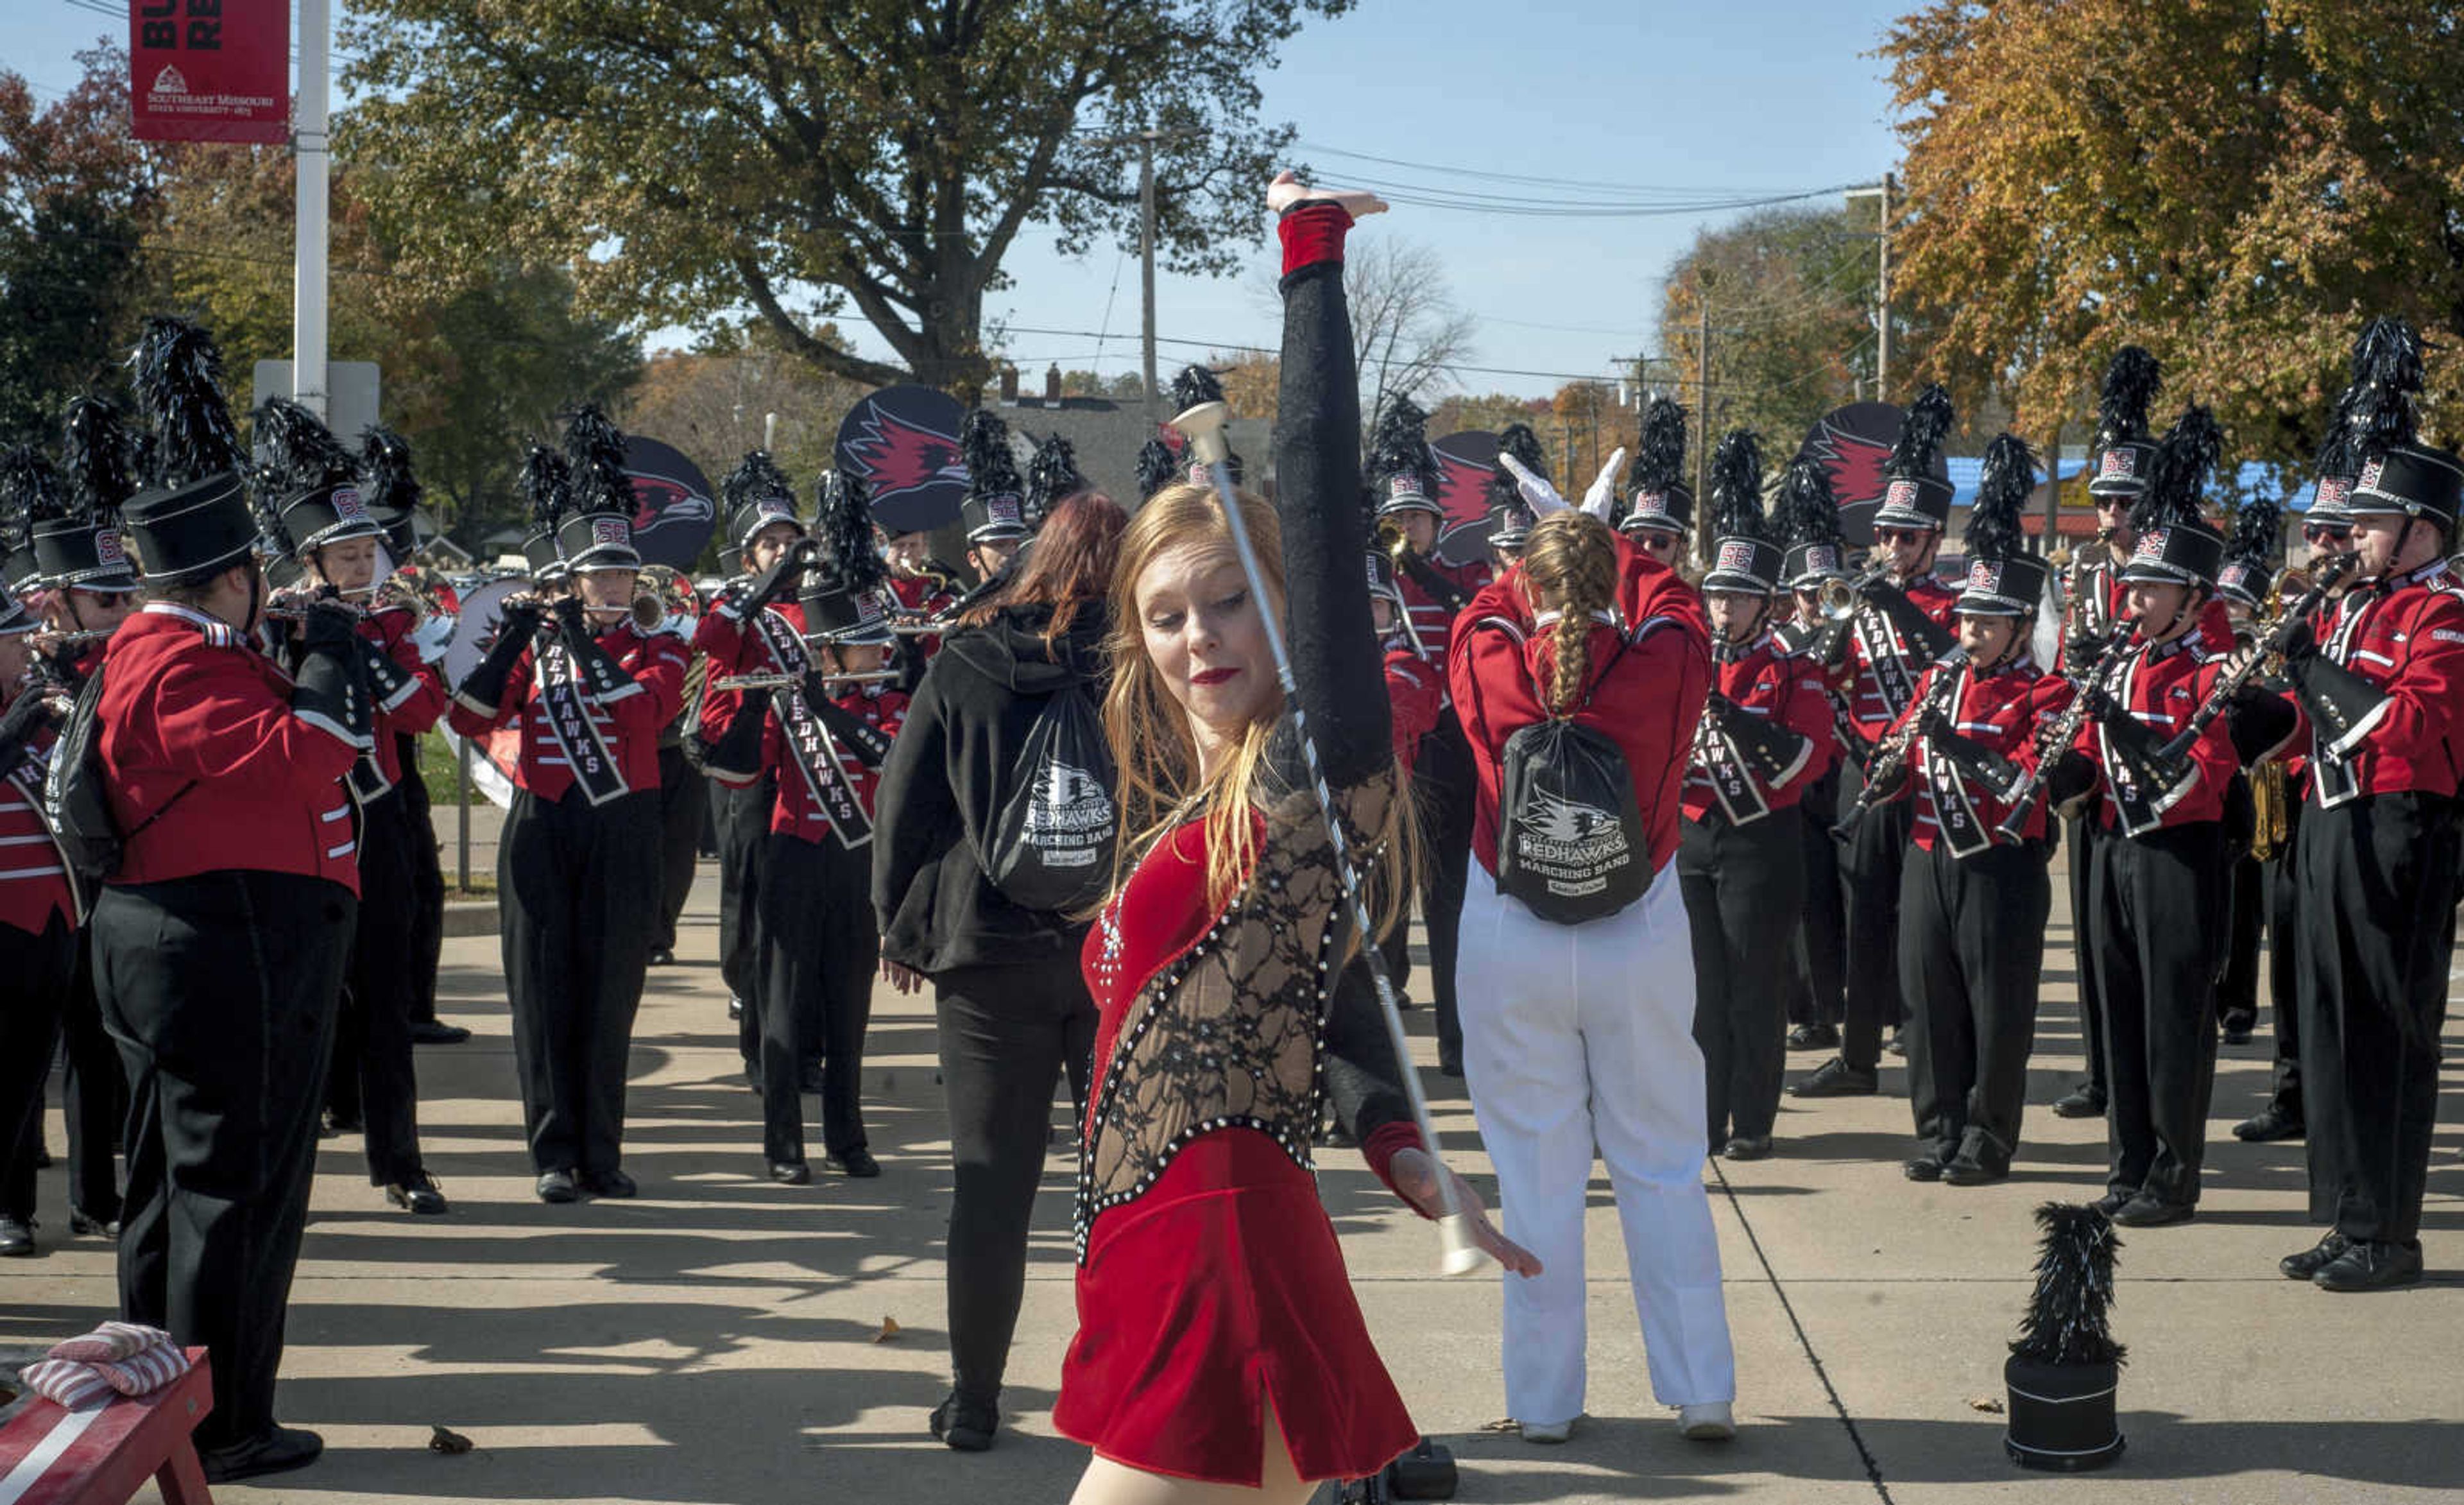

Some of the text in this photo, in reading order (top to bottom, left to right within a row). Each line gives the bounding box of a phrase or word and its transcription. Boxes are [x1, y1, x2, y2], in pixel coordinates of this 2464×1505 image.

[2103, 451, 2134, 474] SE
[1888, 483, 1915, 506] SE
[2319, 479, 2349, 502] SE
[1720, 546, 1753, 569] SE
[547, 644, 600, 774] REDHAWKS
[1026, 804, 1113, 827] REDHAWKS
[1020, 832, 1084, 847] MARCHING
[1521, 836, 1625, 863] REDHAWKS
[1519, 854, 1630, 879] MARCHING BAND
